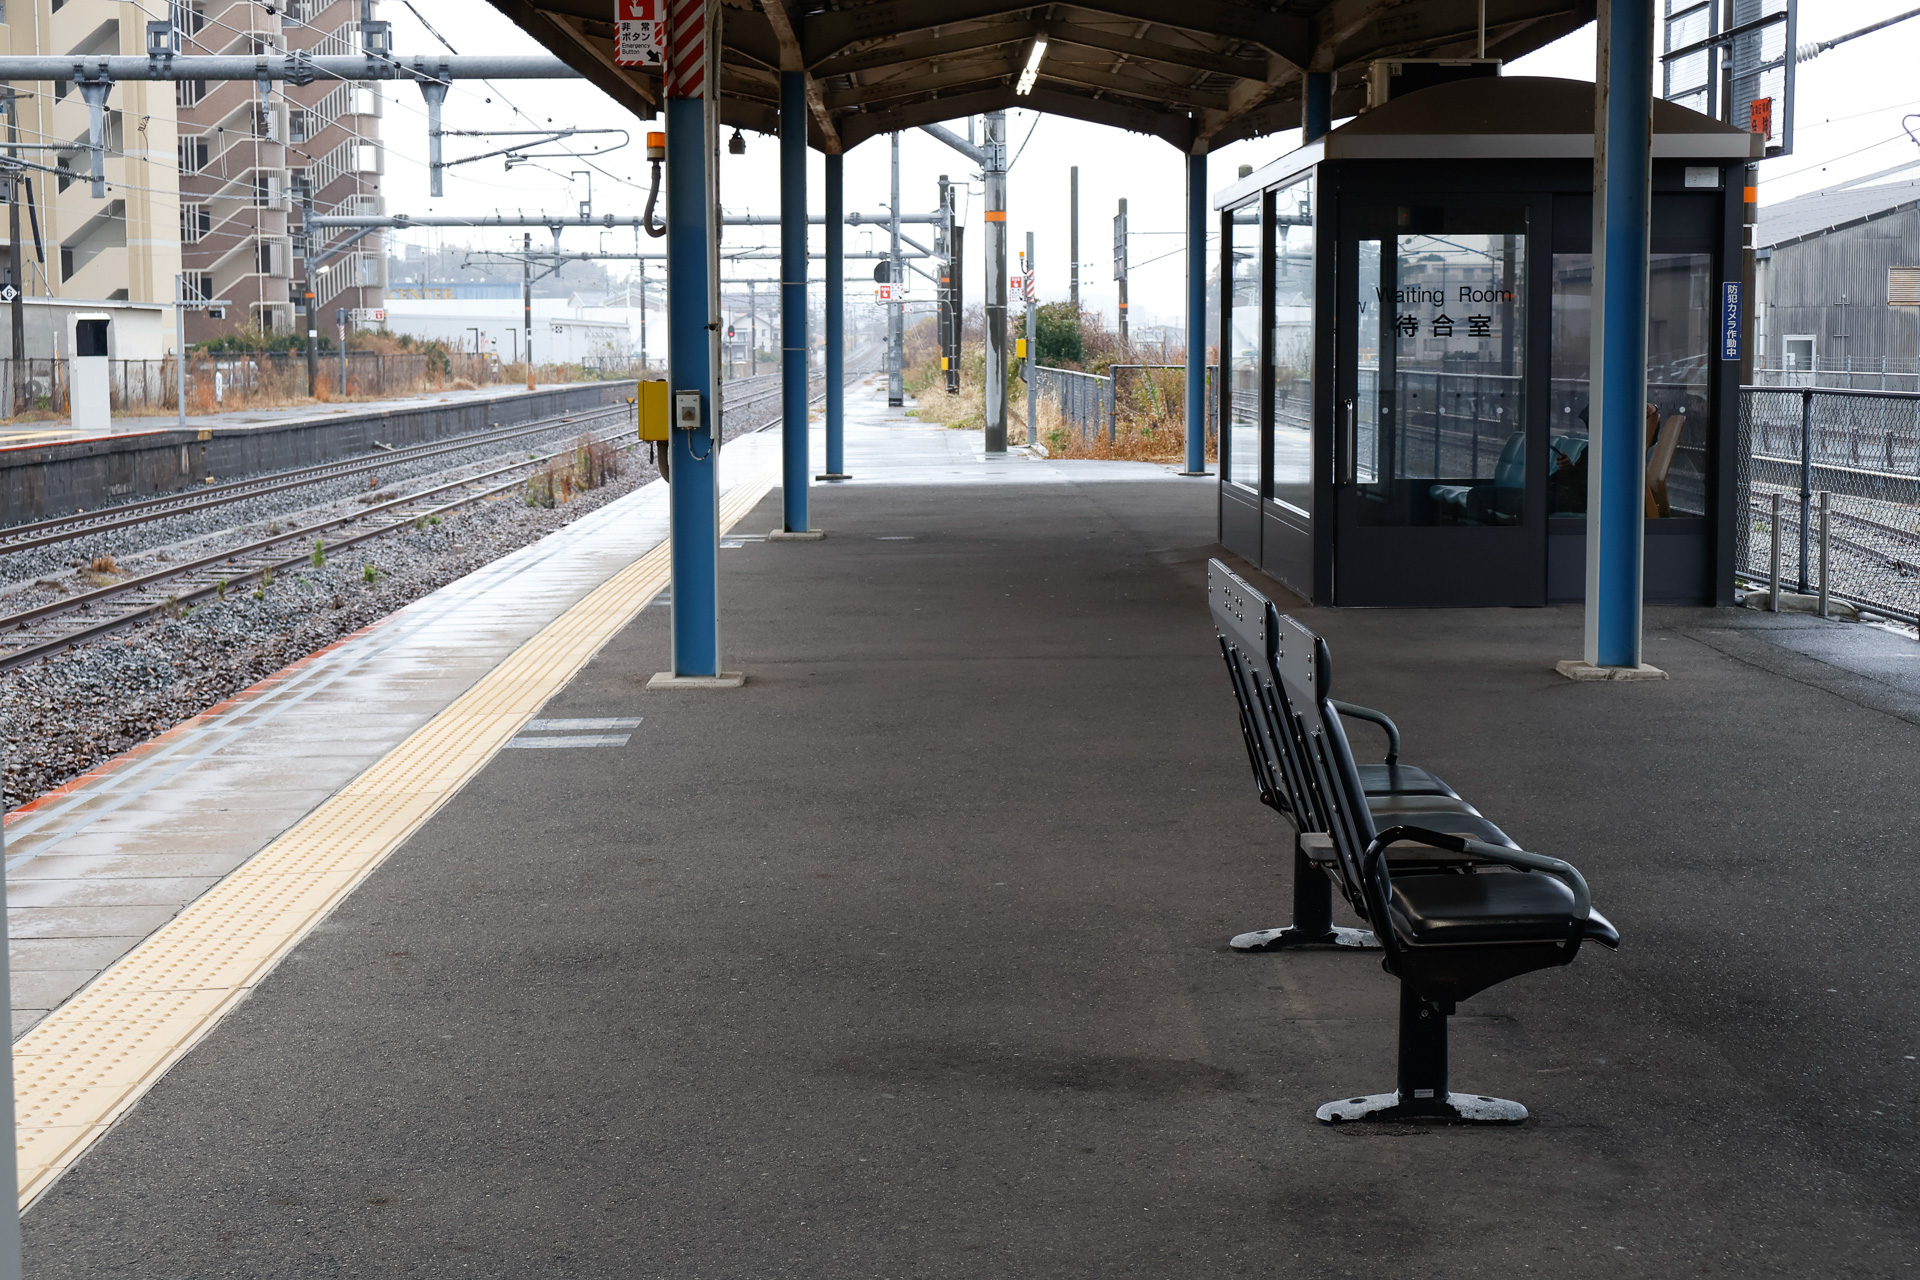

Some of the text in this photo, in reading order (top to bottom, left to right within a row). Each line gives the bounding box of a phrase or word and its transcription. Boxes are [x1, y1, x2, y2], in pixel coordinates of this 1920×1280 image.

[622, 22, 650, 31] 非常
[622, 32, 650, 41] ボタン
[6, 289, 13, 298] 6
[1376, 287, 1511, 307] Waiting Room
[1396, 314, 1491, 337] 待合室
[1726, 285, 1738, 357] 防犯カメラ作動中
